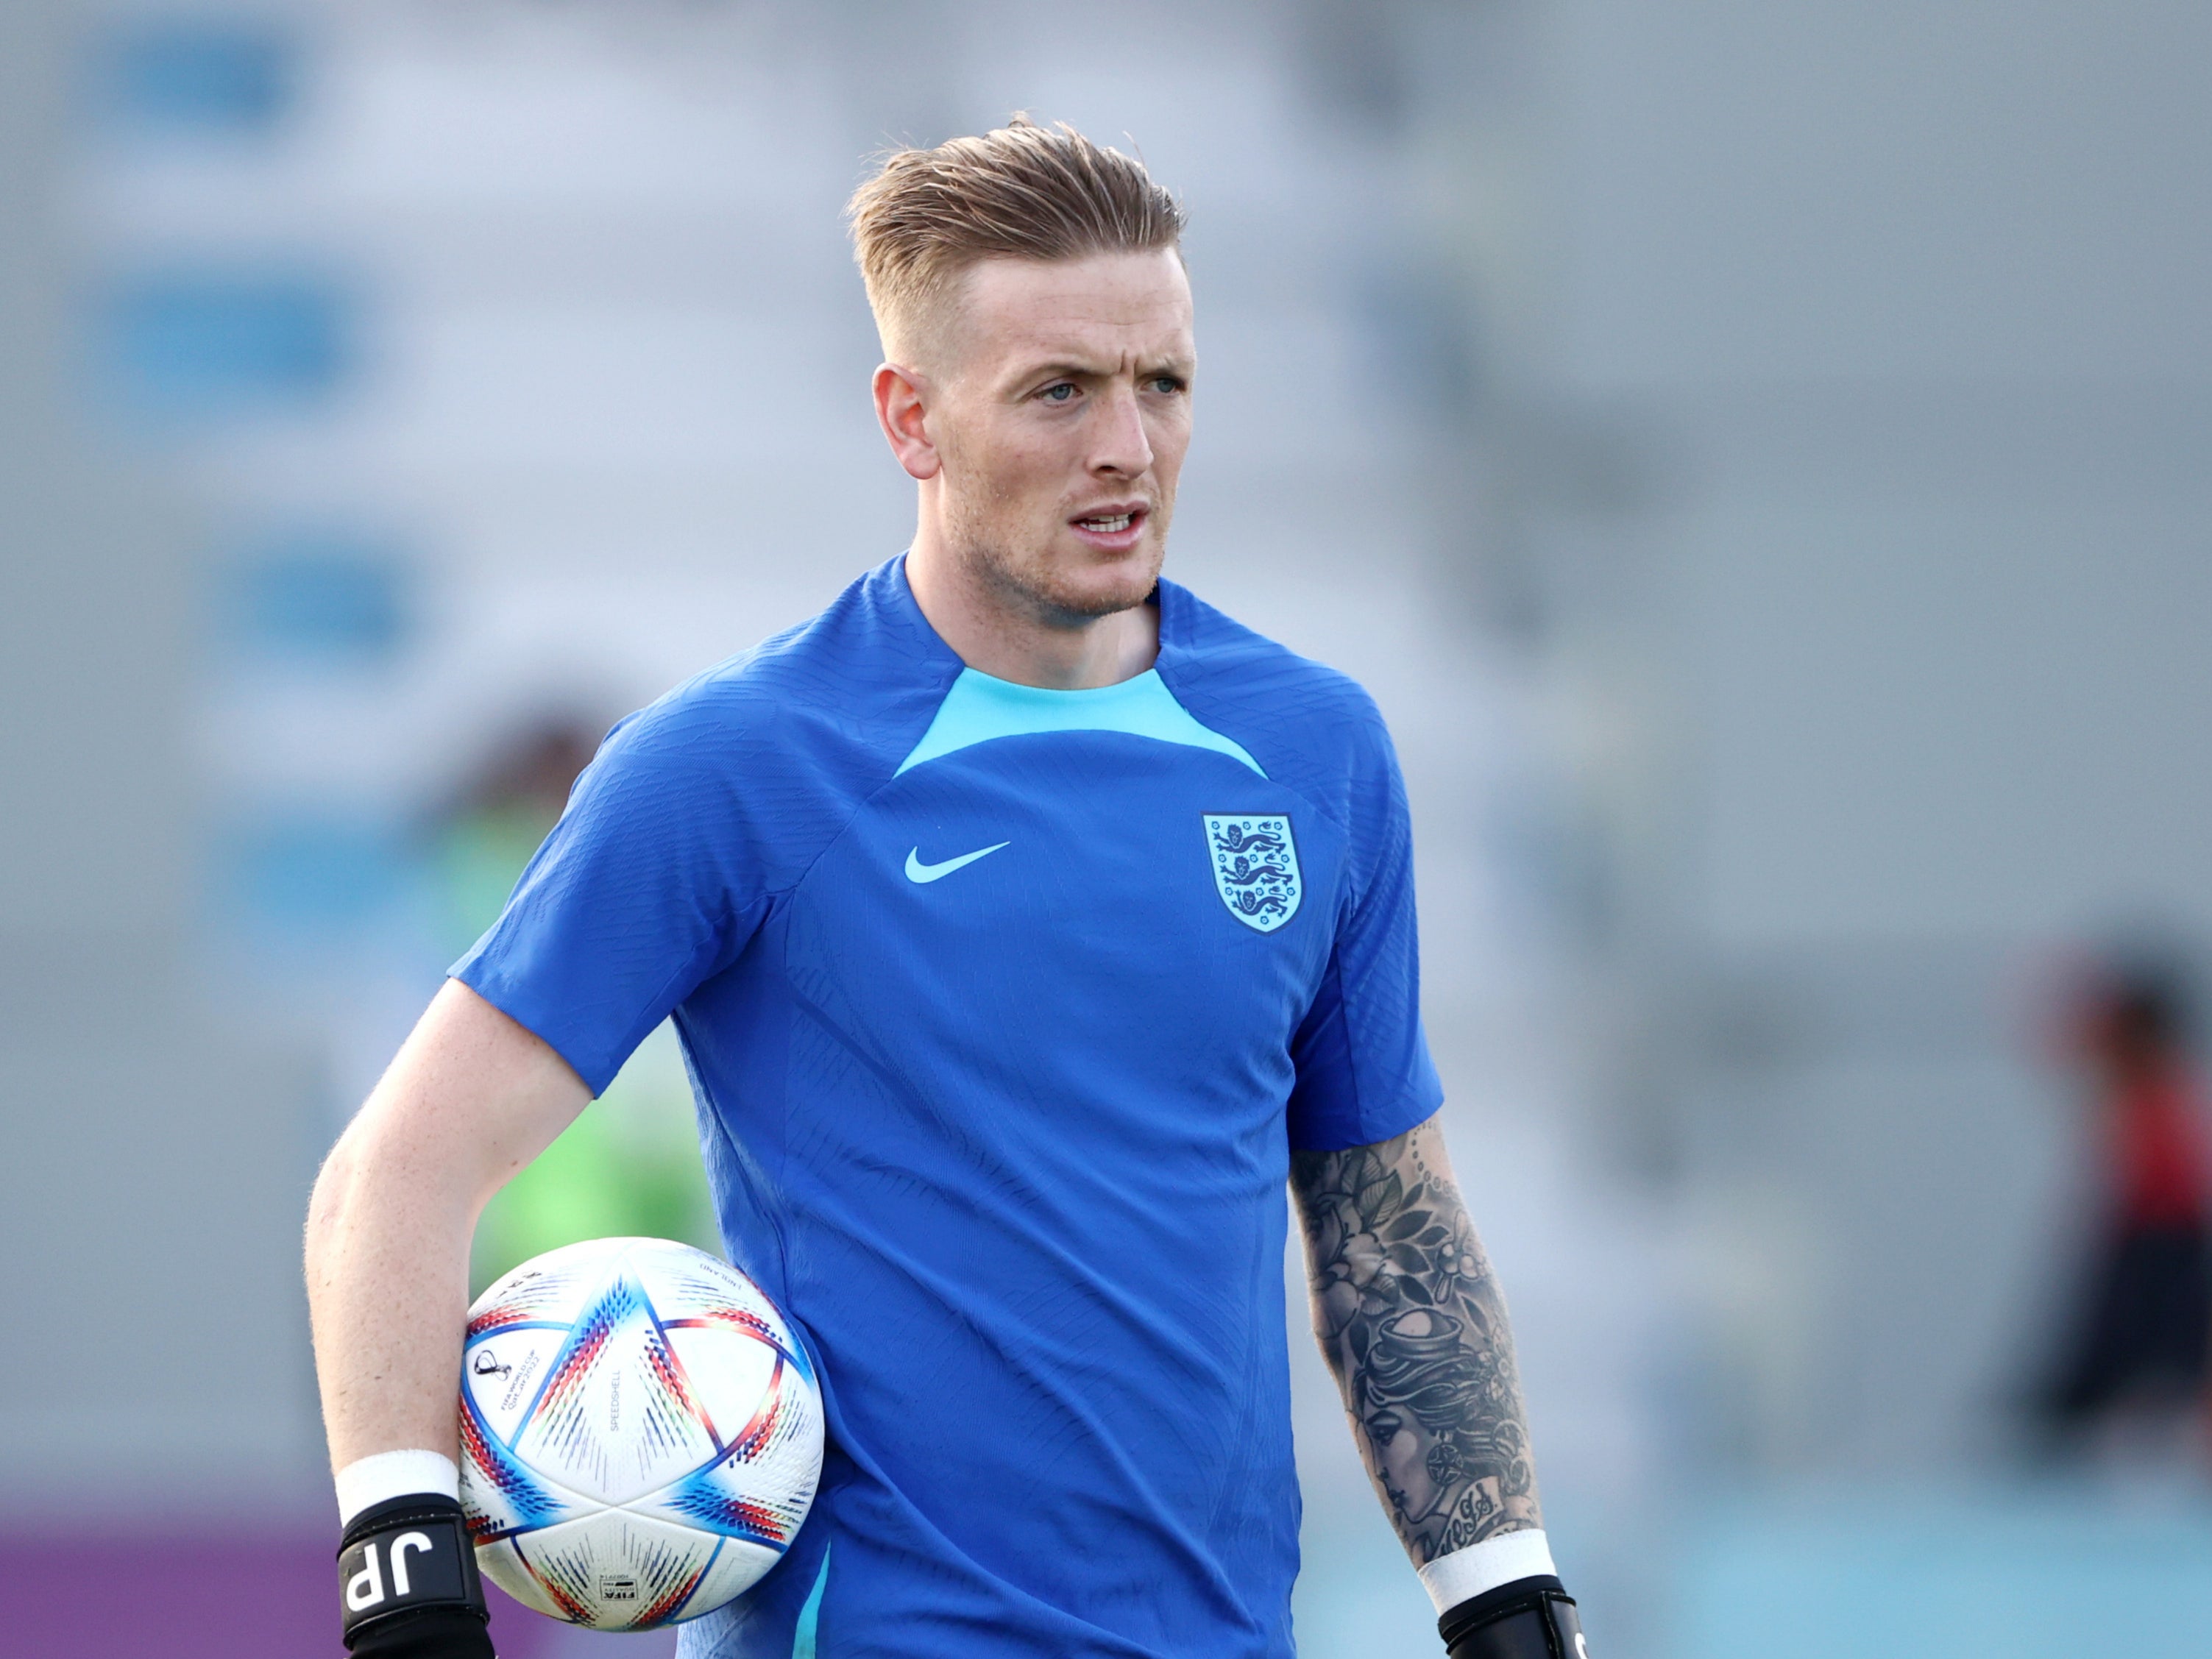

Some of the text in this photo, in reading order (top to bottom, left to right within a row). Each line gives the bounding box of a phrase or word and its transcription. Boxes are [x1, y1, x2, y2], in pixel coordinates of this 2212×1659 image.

[500, 1349, 535, 1411] FIFA WORLD CUP
[611, 1370, 620, 1432] SPEEDSHELL
[346, 1530, 433, 1613] JP
